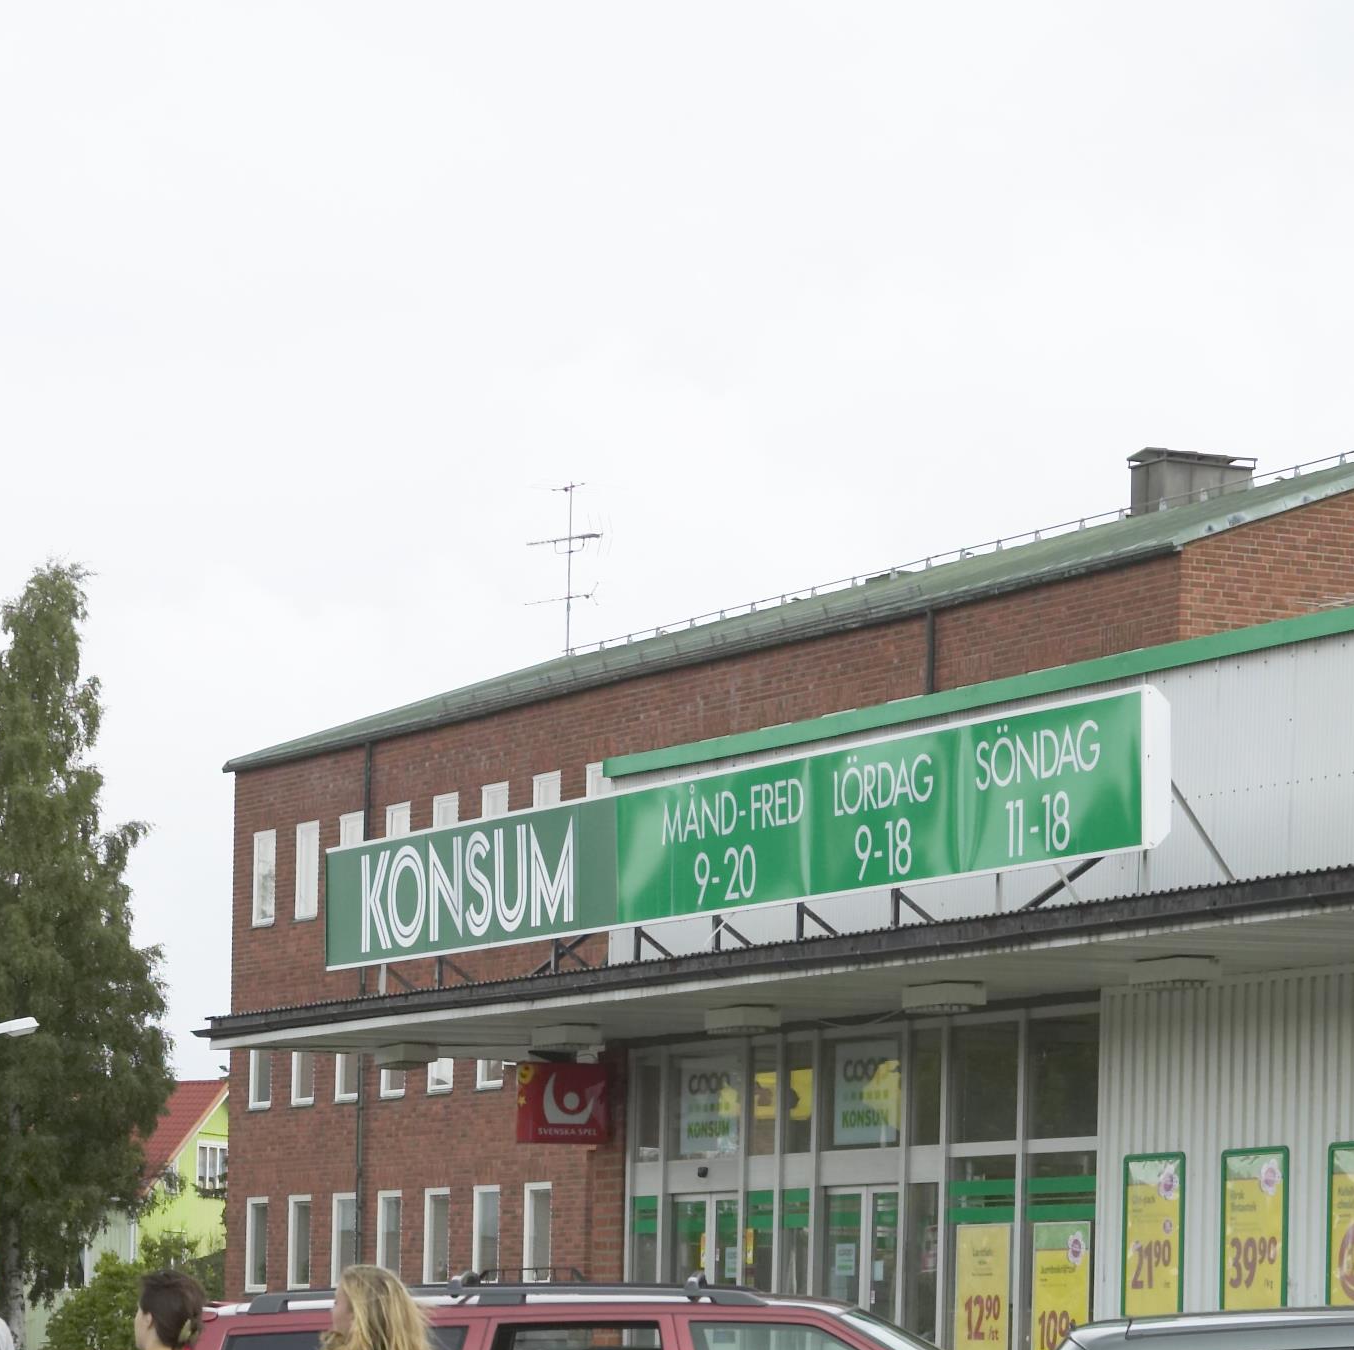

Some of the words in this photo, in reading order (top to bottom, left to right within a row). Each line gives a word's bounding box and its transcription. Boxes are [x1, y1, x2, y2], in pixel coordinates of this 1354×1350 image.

[833, 753, 934, 818] LÖRDAG
[975, 719, 1101, 792] SÖNDAG
[693, 844, 757, 907] 9-20
[854, 817, 913, 882] 9-18
[360, 815, 575, 954] KONSUM
[537, 1127, 577, 1137] SVENSKA
[577, 1127, 598, 1137] SPEL
[687, 1119, 729, 1137] KONSUM
[842, 1107, 889, 1129] KONSUM
